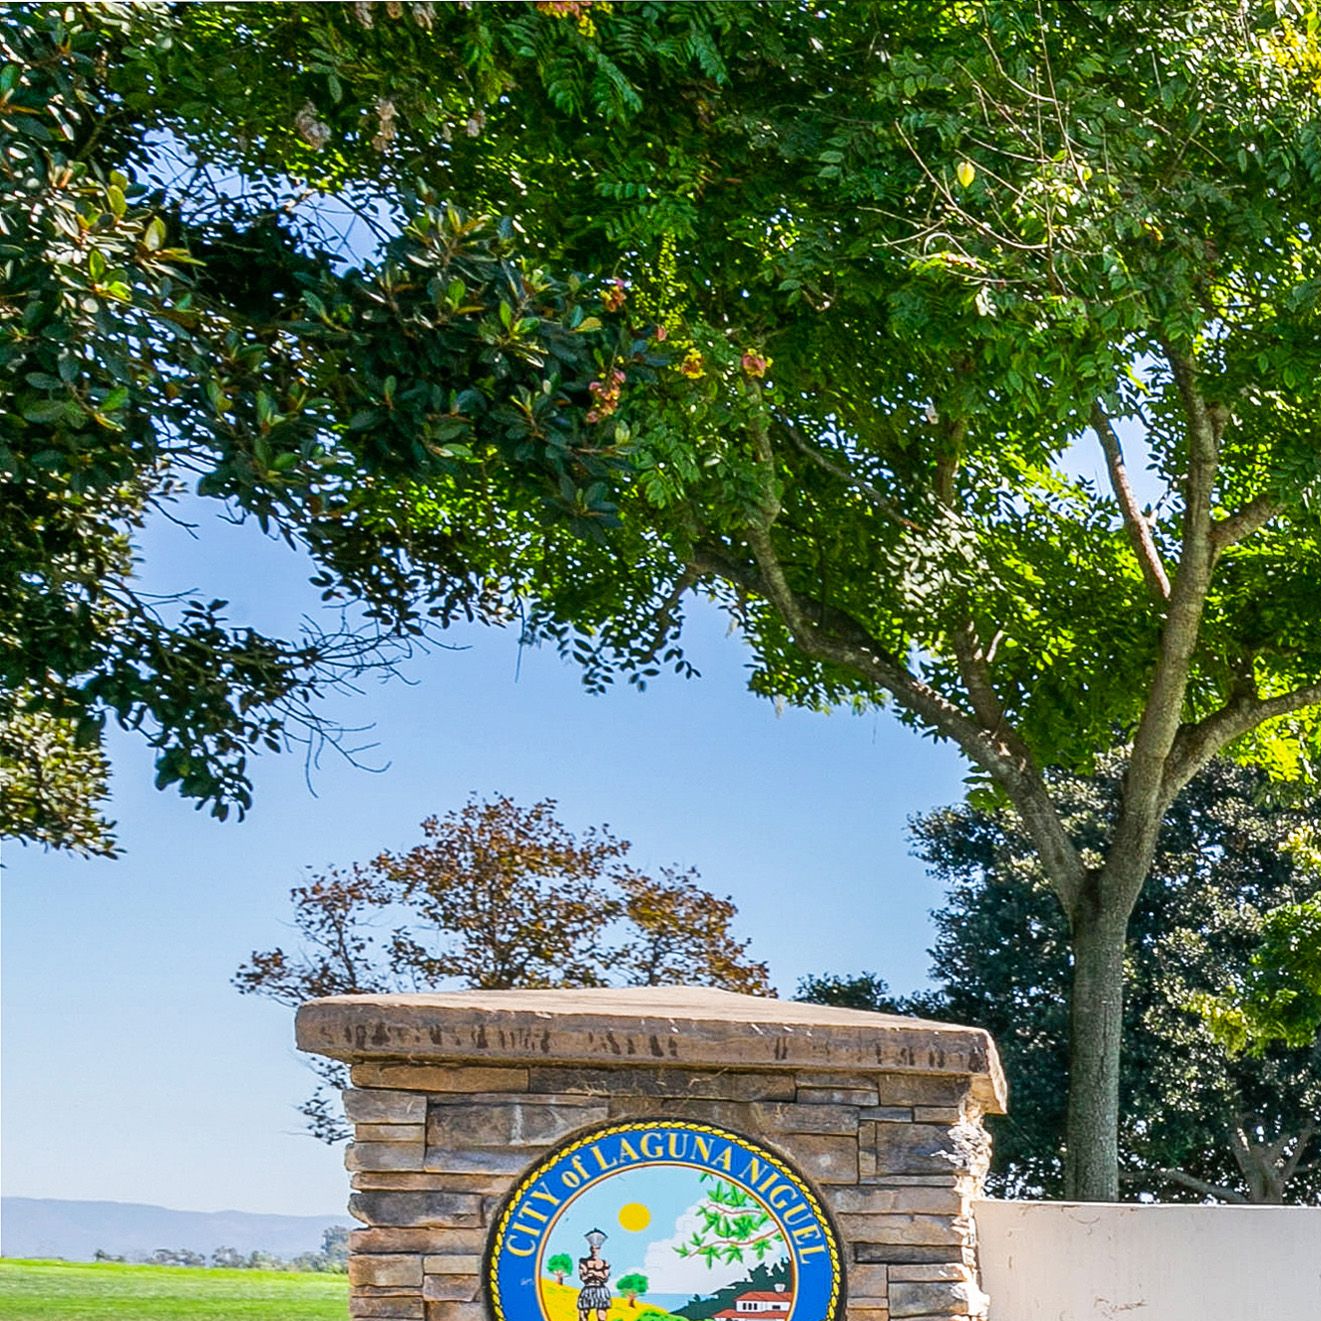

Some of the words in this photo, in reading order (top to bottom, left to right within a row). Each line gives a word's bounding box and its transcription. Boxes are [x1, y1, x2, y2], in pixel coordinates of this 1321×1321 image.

[506, 1183, 561, 1257] CITY
[561, 1156, 592, 1189] of
[588, 1132, 732, 1171] LAGUNA
[738, 1158, 827, 1266] NIGUEL
